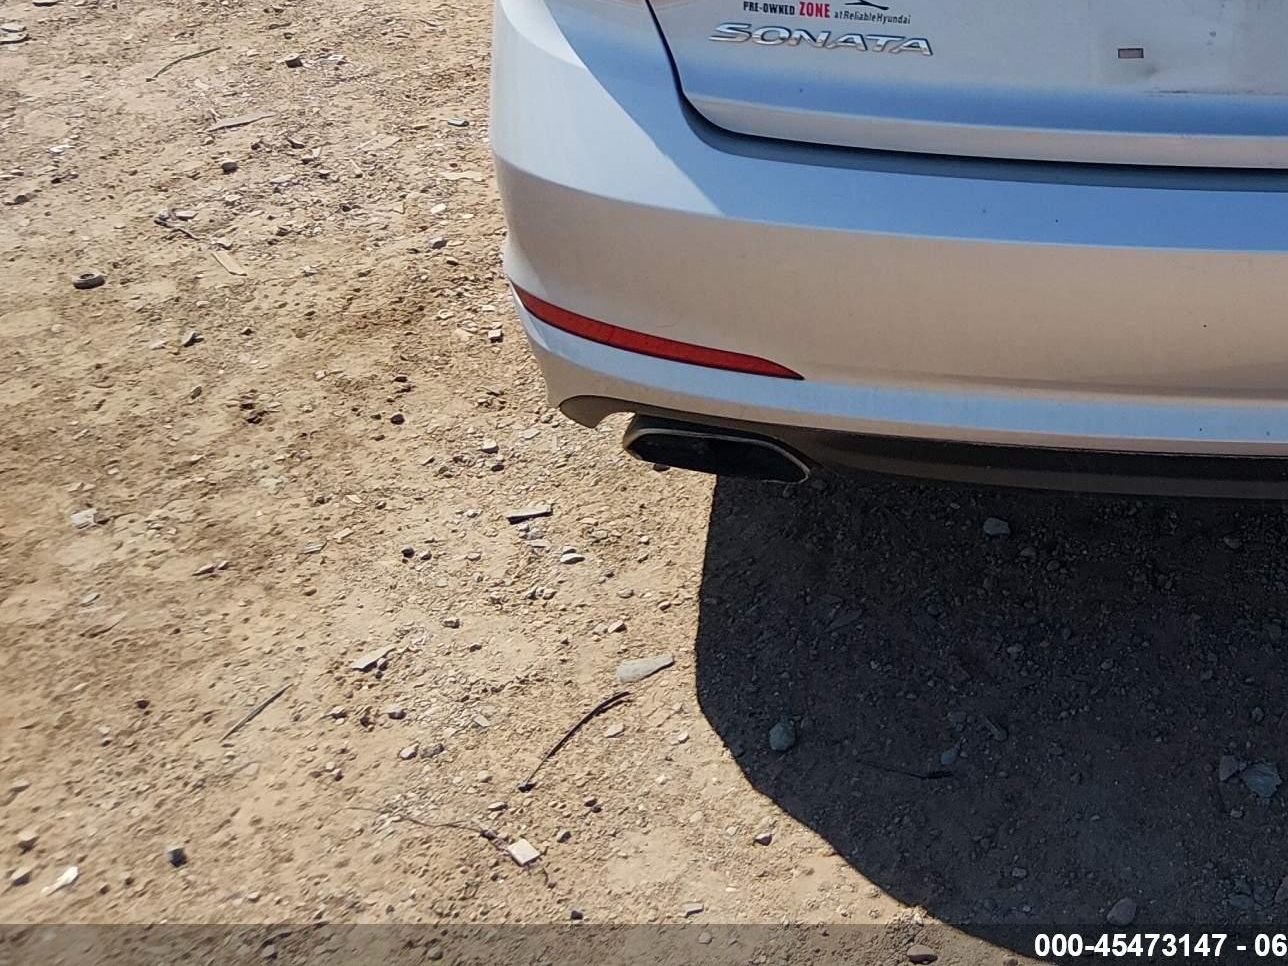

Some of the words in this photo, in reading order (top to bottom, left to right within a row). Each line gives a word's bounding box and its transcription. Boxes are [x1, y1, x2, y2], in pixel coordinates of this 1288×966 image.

[743, 0, 795, 17] PRE-OWNED
[799, 0, 831, 19] ZONE
[708, 22, 934, 56] SONATA
